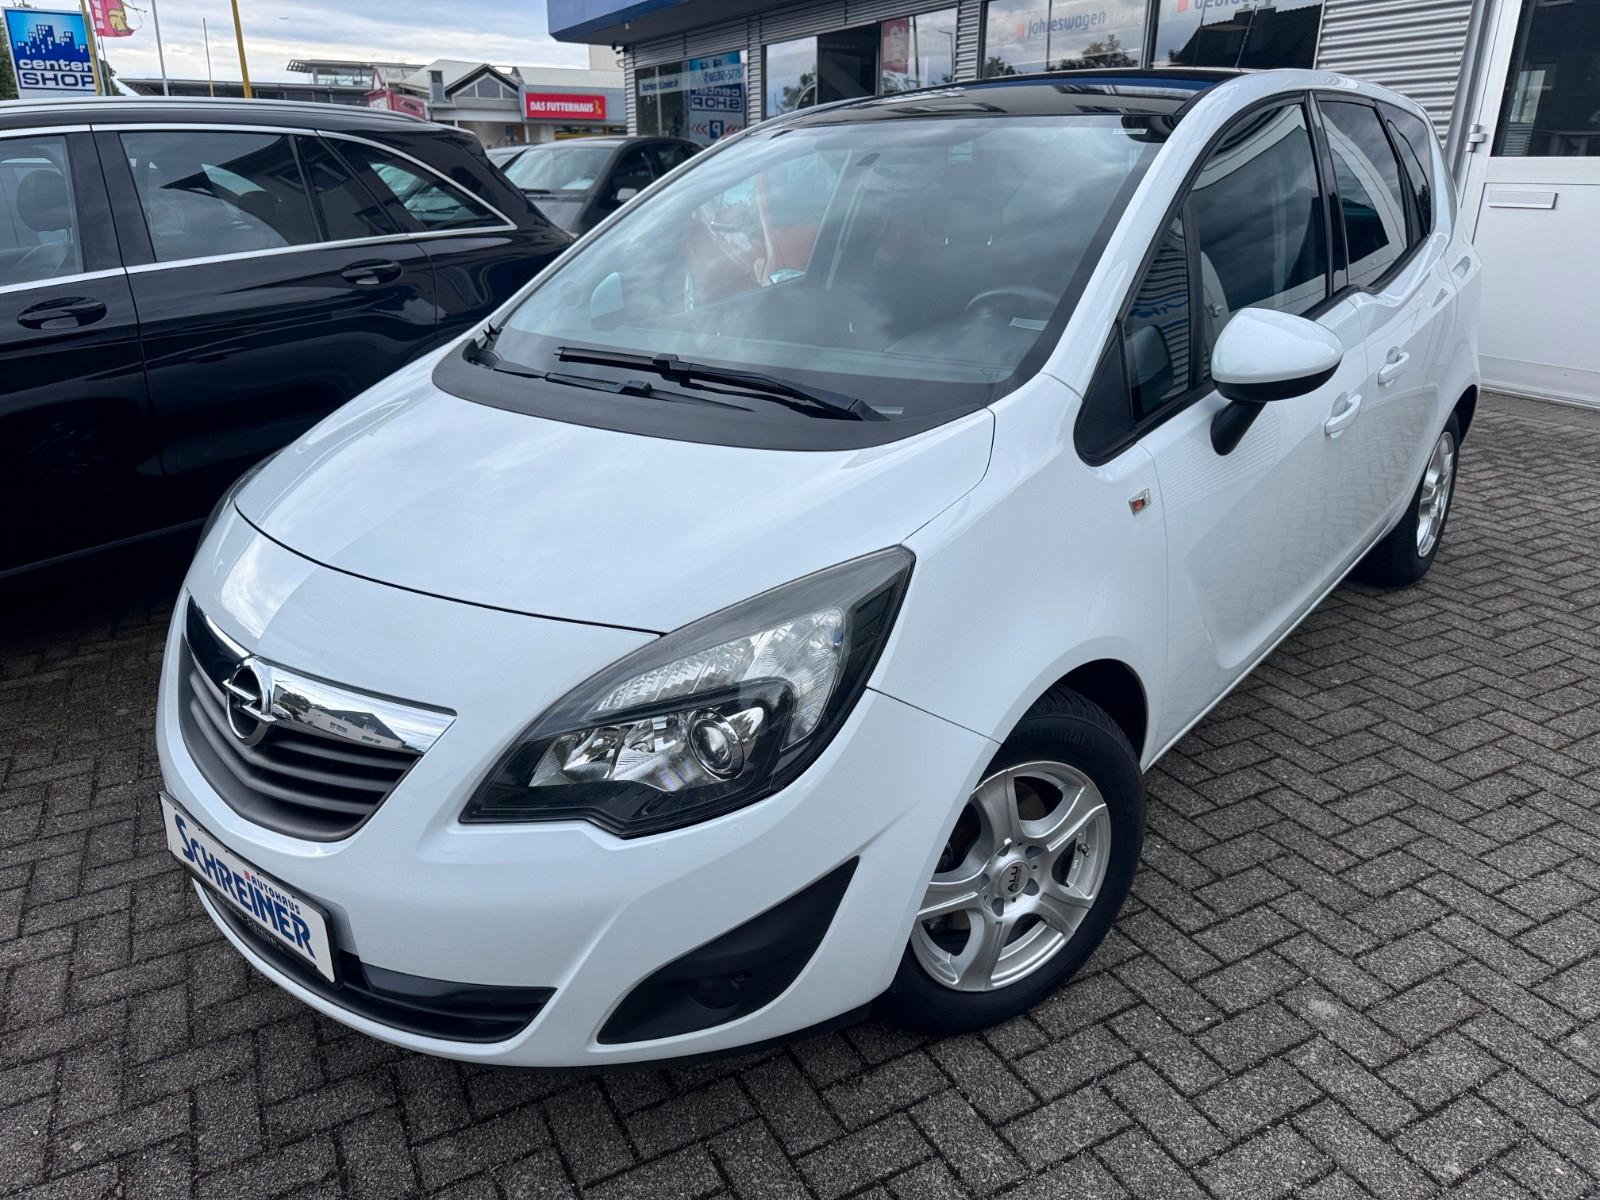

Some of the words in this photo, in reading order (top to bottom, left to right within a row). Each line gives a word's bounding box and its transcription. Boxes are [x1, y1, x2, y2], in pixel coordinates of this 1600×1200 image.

[18, 58, 93, 71] center
[22, 72, 95, 88] SHOP
[530, 101, 545, 111] DAS
[546, 102, 594, 112] FUTTERHAUS
[175, 813, 317, 960] SCHREINER
[1007, 865, 1019, 893] ALU
[251, 876, 301, 915] AUTOHAUS
